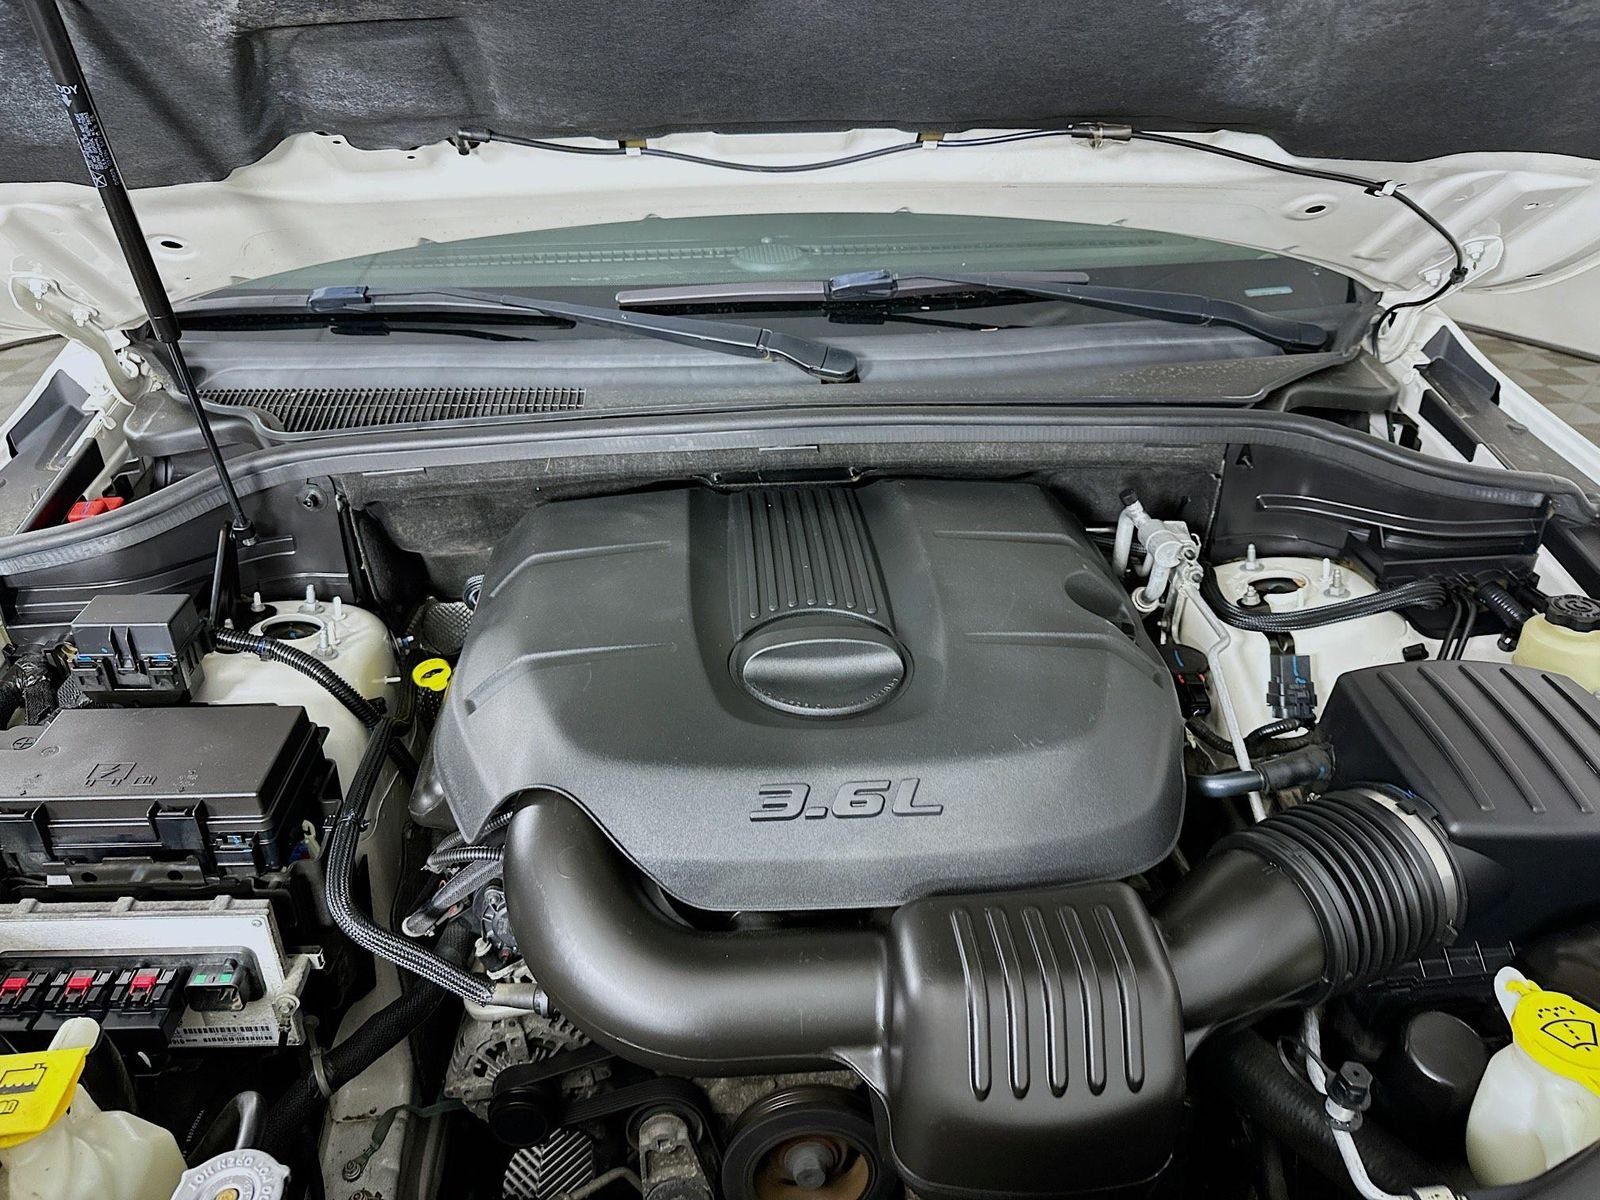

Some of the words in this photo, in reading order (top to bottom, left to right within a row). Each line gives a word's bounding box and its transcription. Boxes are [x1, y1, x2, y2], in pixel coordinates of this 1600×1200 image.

[750, 778, 944, 822] 3.6L
[217, 1156, 254, 1171] OPEN
[188, 1167, 215, 1191] HOT
